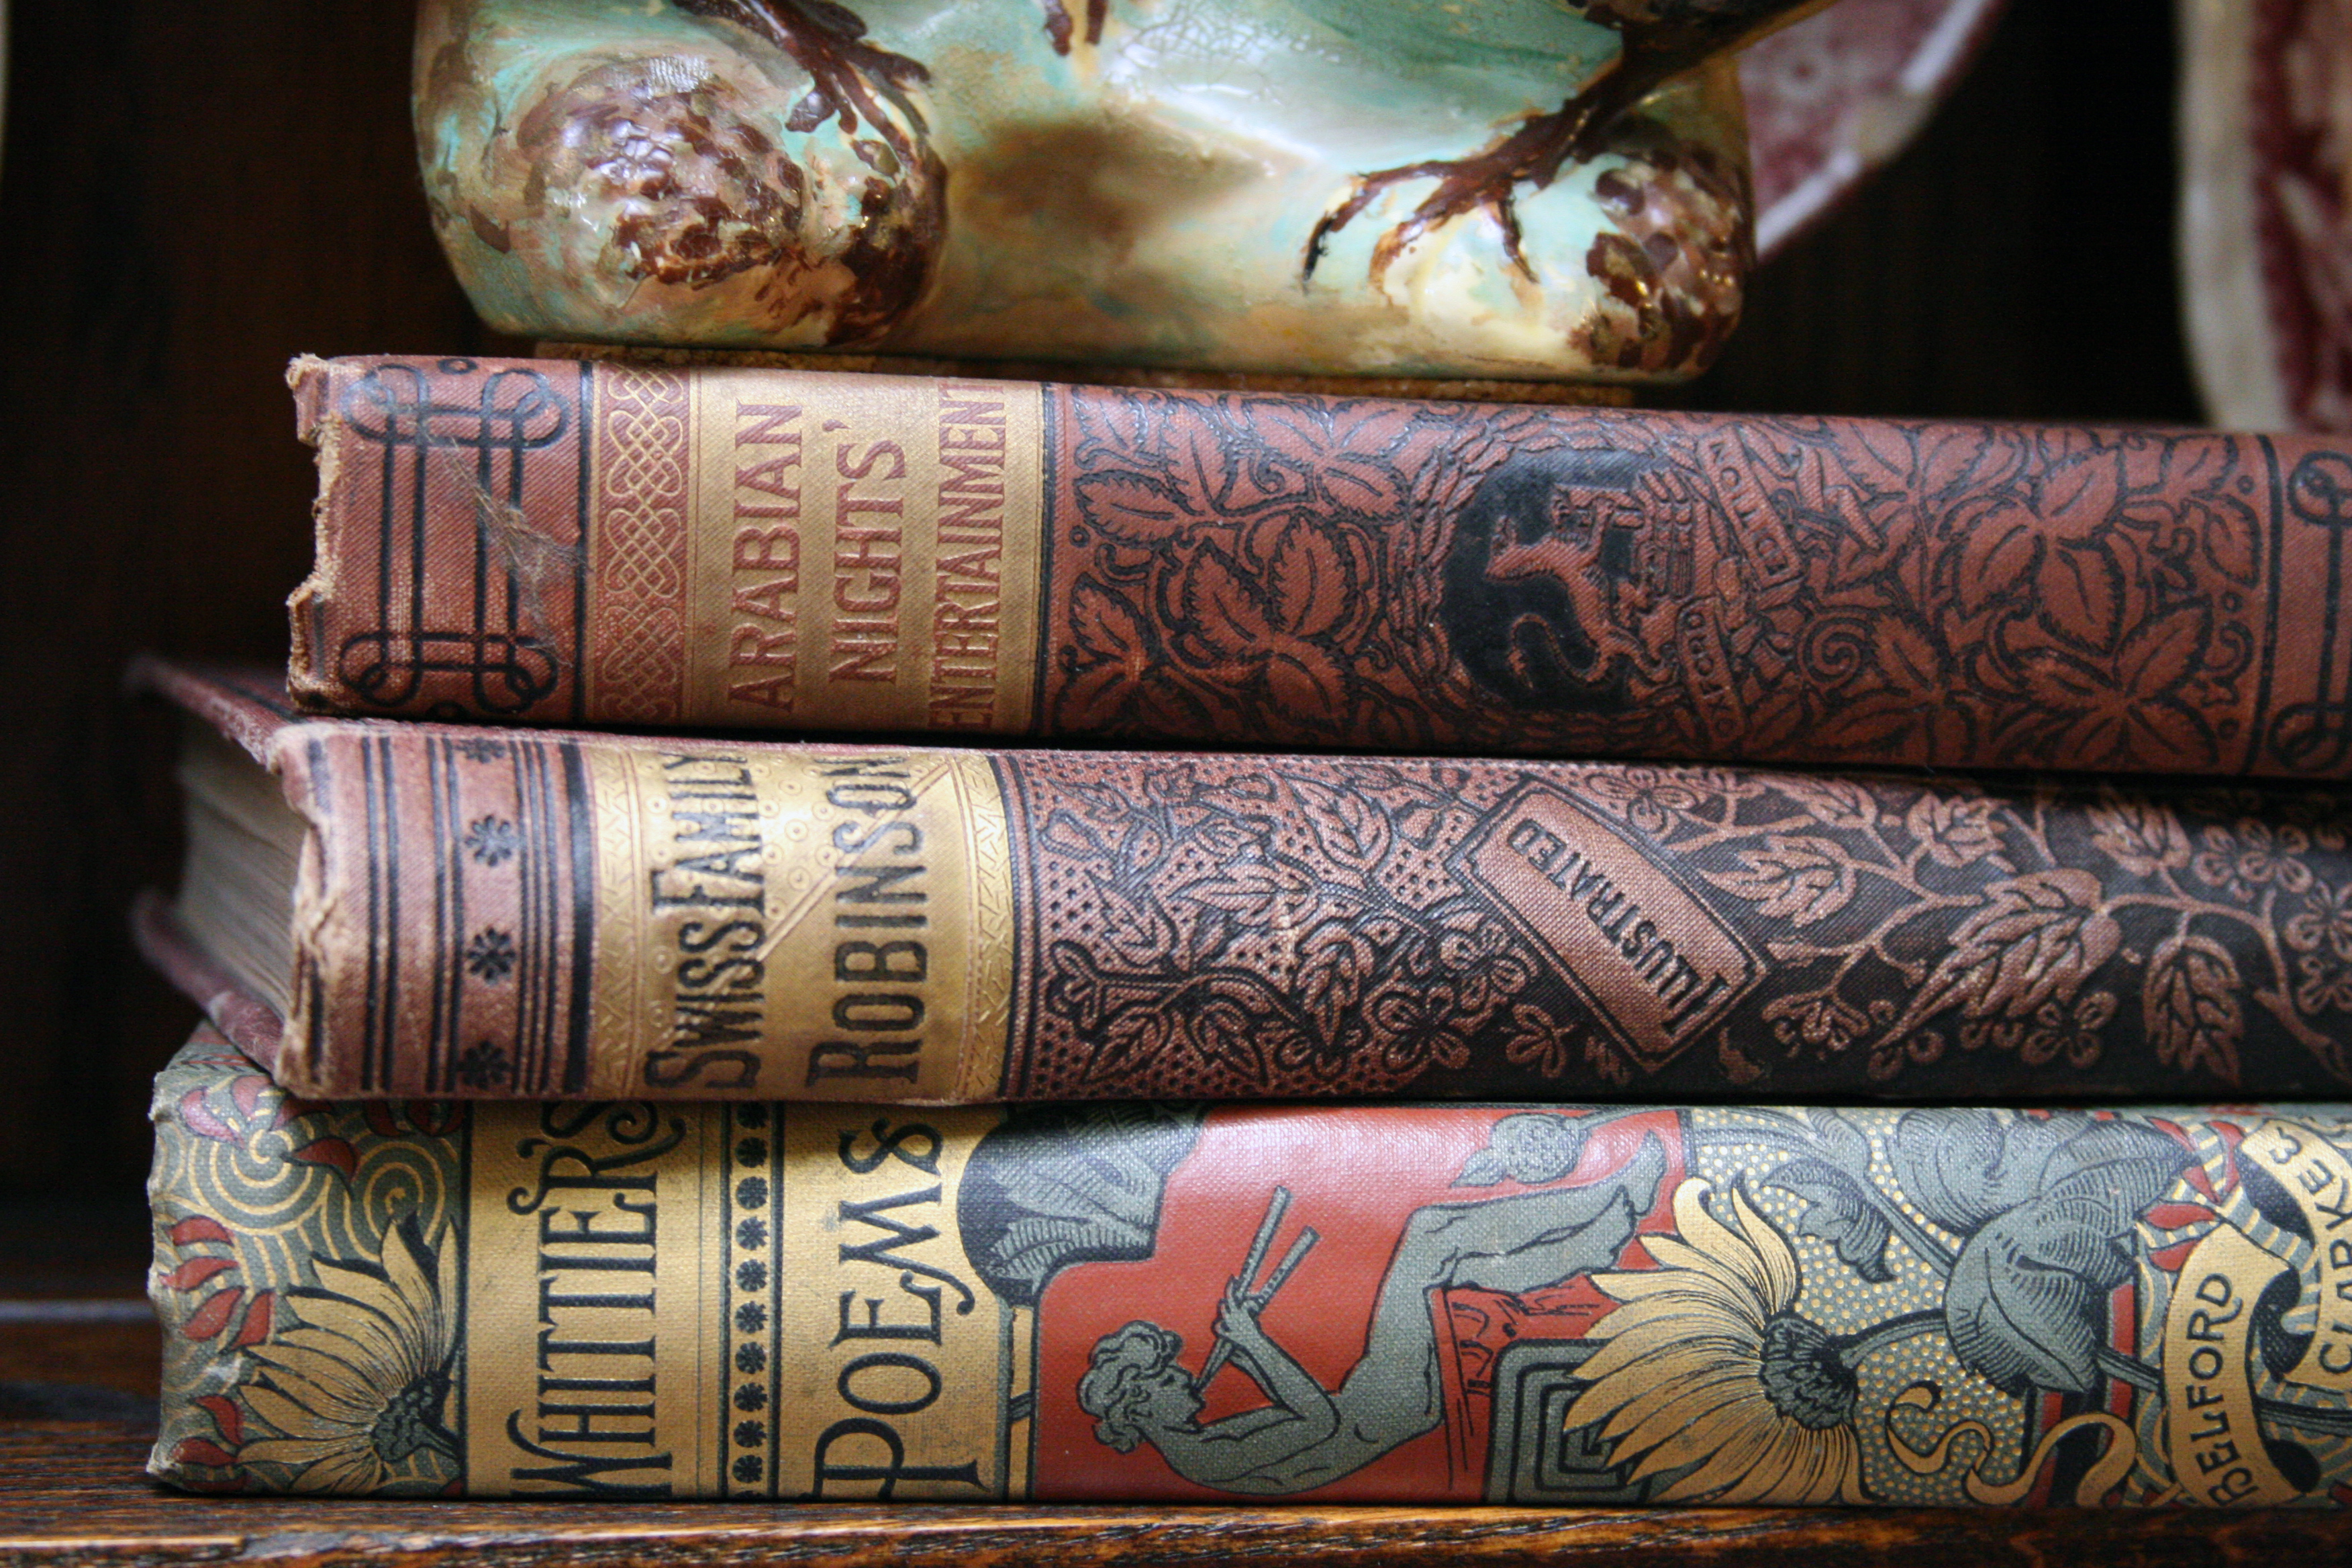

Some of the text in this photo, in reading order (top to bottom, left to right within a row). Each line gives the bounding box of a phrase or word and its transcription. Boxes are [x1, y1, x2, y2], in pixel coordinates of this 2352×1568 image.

[727, 398, 802, 712] ARABIAN
[822, 418, 906, 685] NIGHTS'
[1709, 441, 1789, 577] EDITION
[1682, 611, 1735, 733] OXFORD
[642, 752, 767, 1090] SWISS FAMILY
[804, 754, 928, 1087] ROBINSON
[1508, 818, 1730, 1032] ILLUSTRATED
[506, 1101, 685, 1498] WHITTIER'S
[812, 1121, 988, 1498] POEMS
[2188, 1271, 2260, 1507] BELFORD
